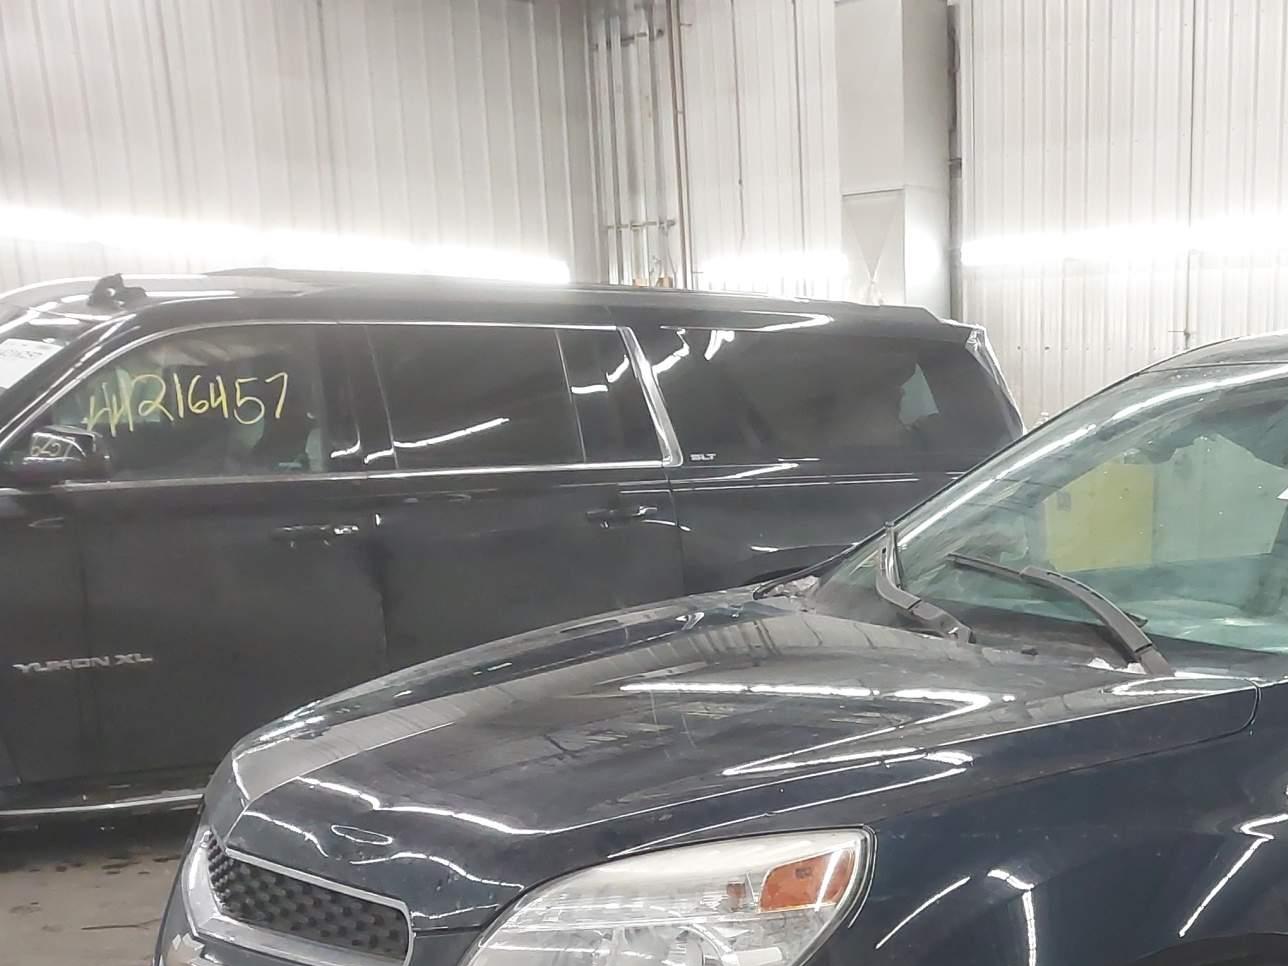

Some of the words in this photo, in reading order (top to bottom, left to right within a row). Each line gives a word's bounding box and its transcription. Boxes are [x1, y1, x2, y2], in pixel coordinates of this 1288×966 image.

[81, 372, 289, 437] 44216457
[690, 453, 717, 461] SLT
[12, 655, 110, 673] YUKON
[114, 653, 153, 665] XL
